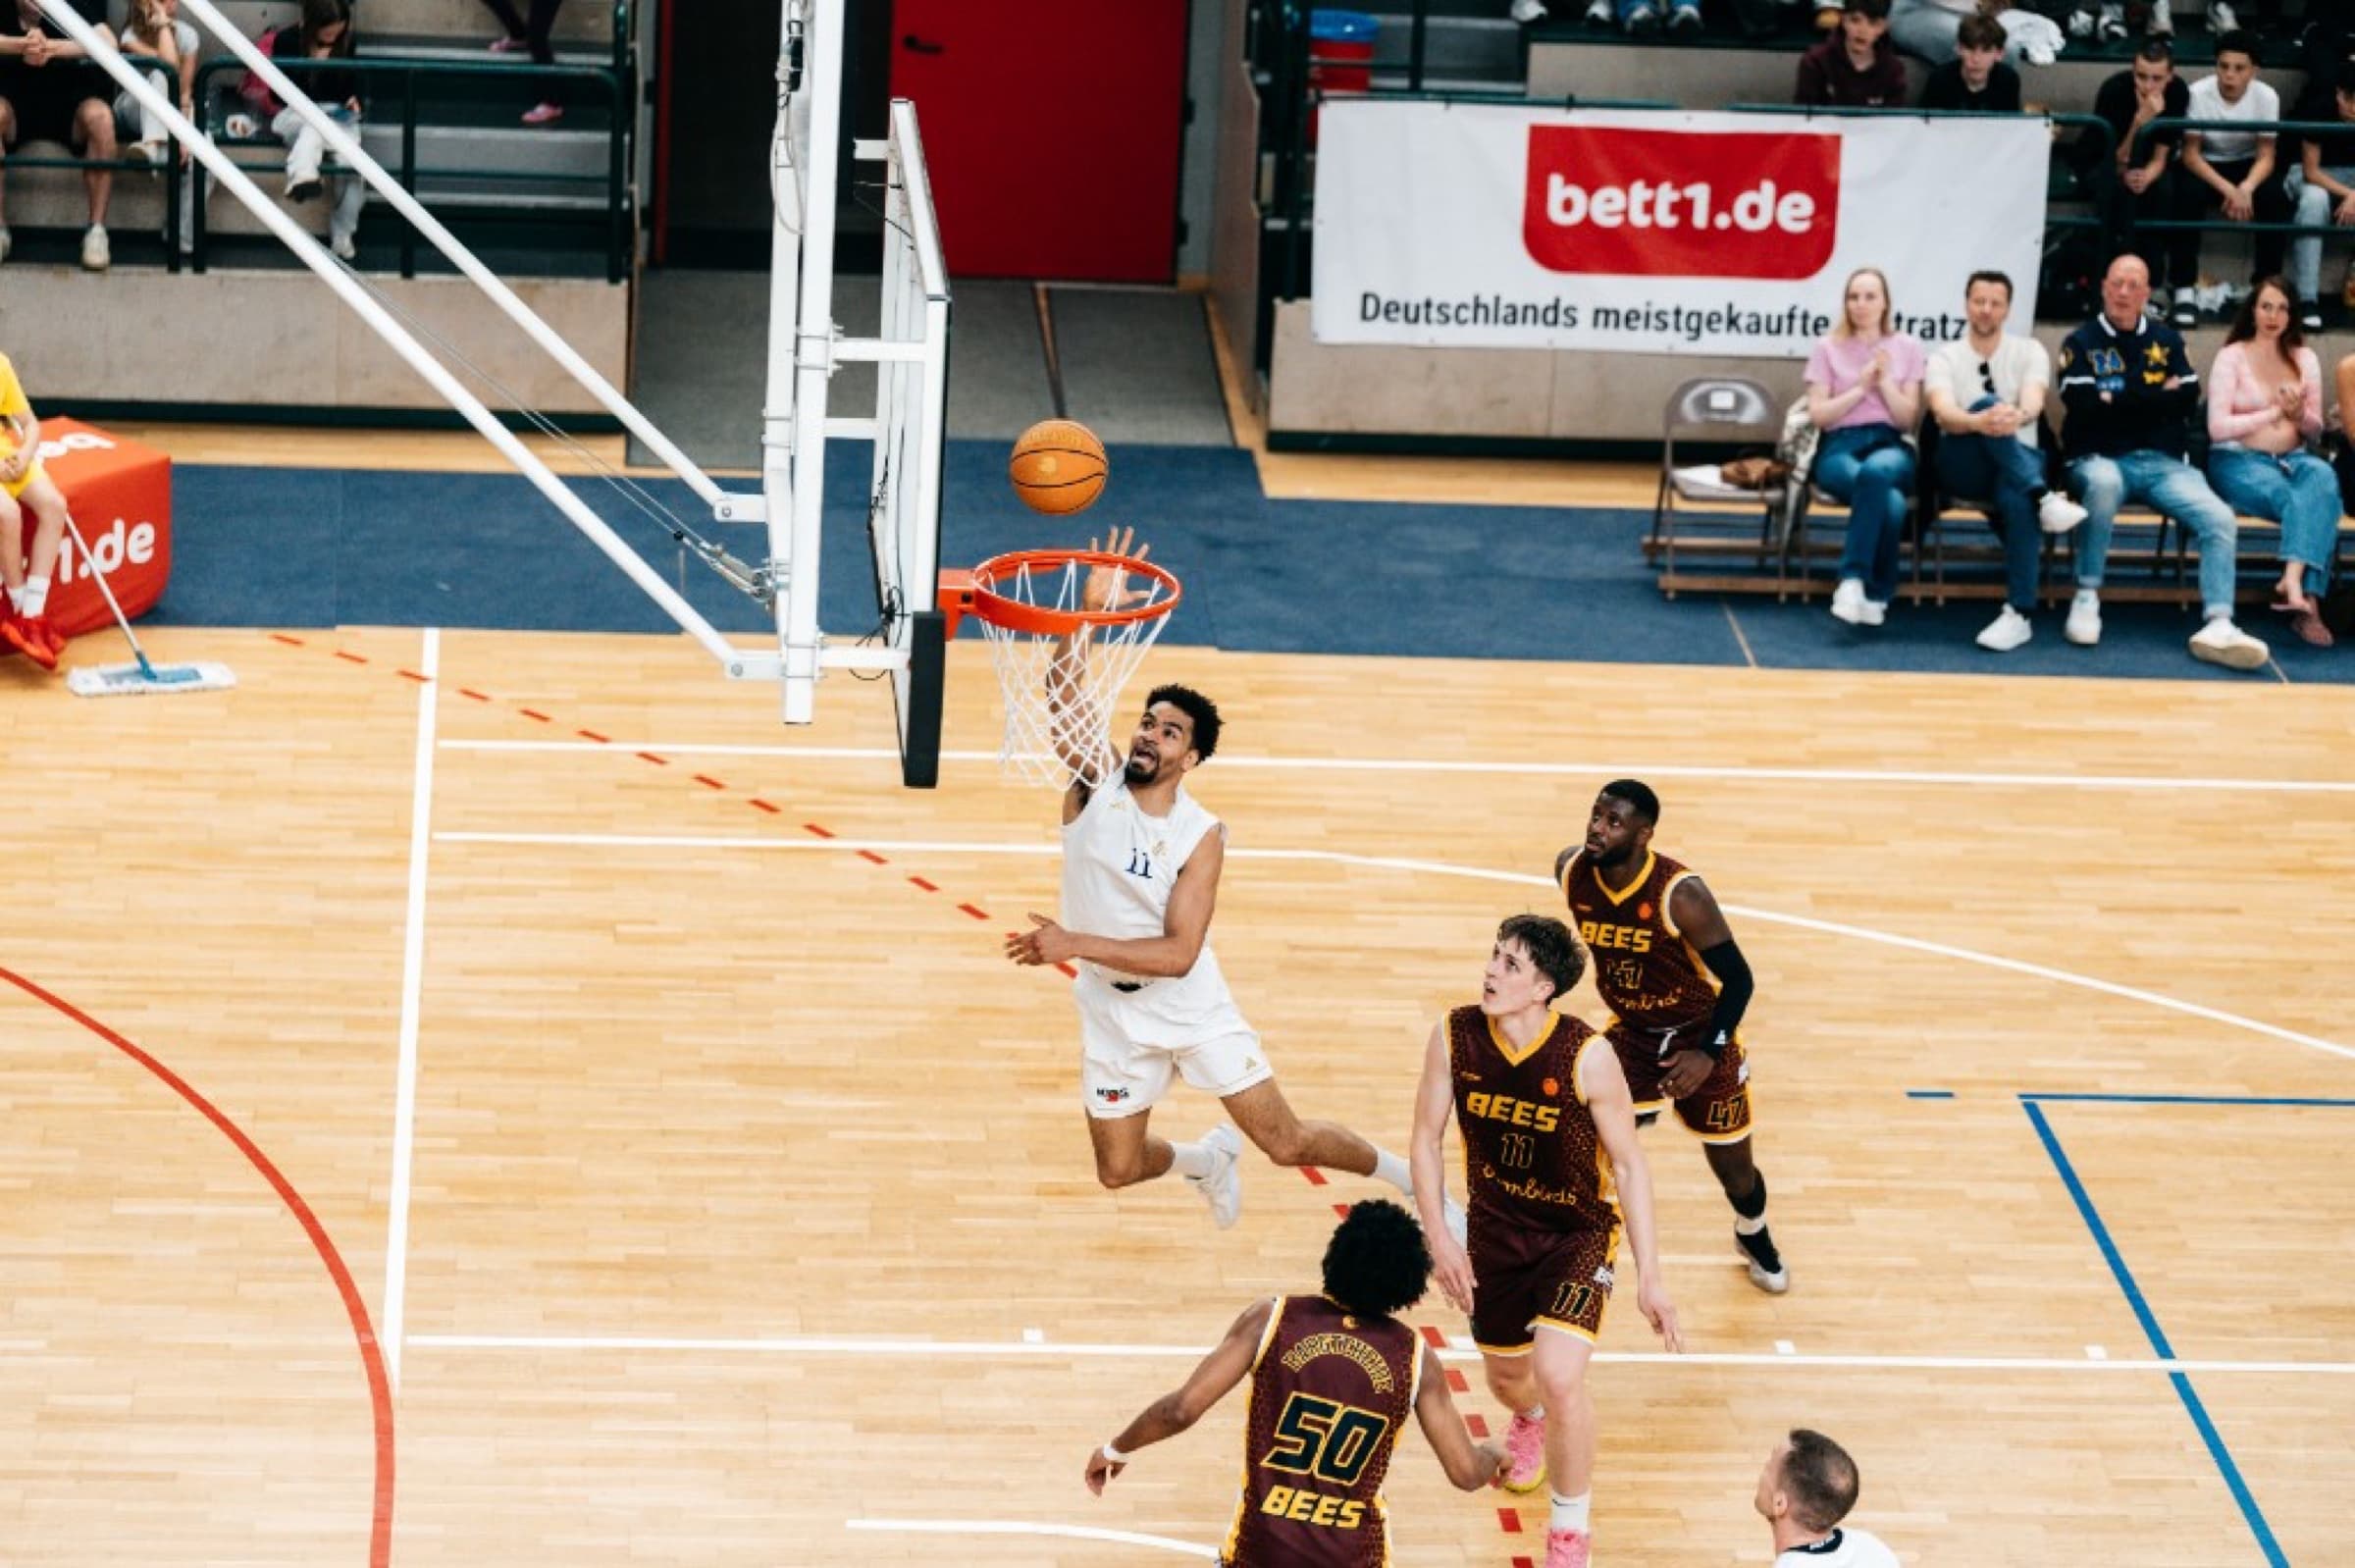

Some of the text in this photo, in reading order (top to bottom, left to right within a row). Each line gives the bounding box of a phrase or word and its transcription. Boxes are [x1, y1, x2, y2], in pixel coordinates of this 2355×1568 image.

[1546, 172, 1816, 235] bett1.de
[1360, 291, 1579, 329] Deutschlands
[1593, 301, 1831, 341] meistgekaufte
[1124, 847, 1153, 879] 11
[1581, 920, 1653, 953] BEES
[1466, 1091, 1561, 1132] BEES
[1500, 1132, 1535, 1169] 11
[1551, 1281, 1595, 1319] 11
[1260, 1390, 1390, 1487] 50
[1260, 1484, 1367, 1529] BEES
